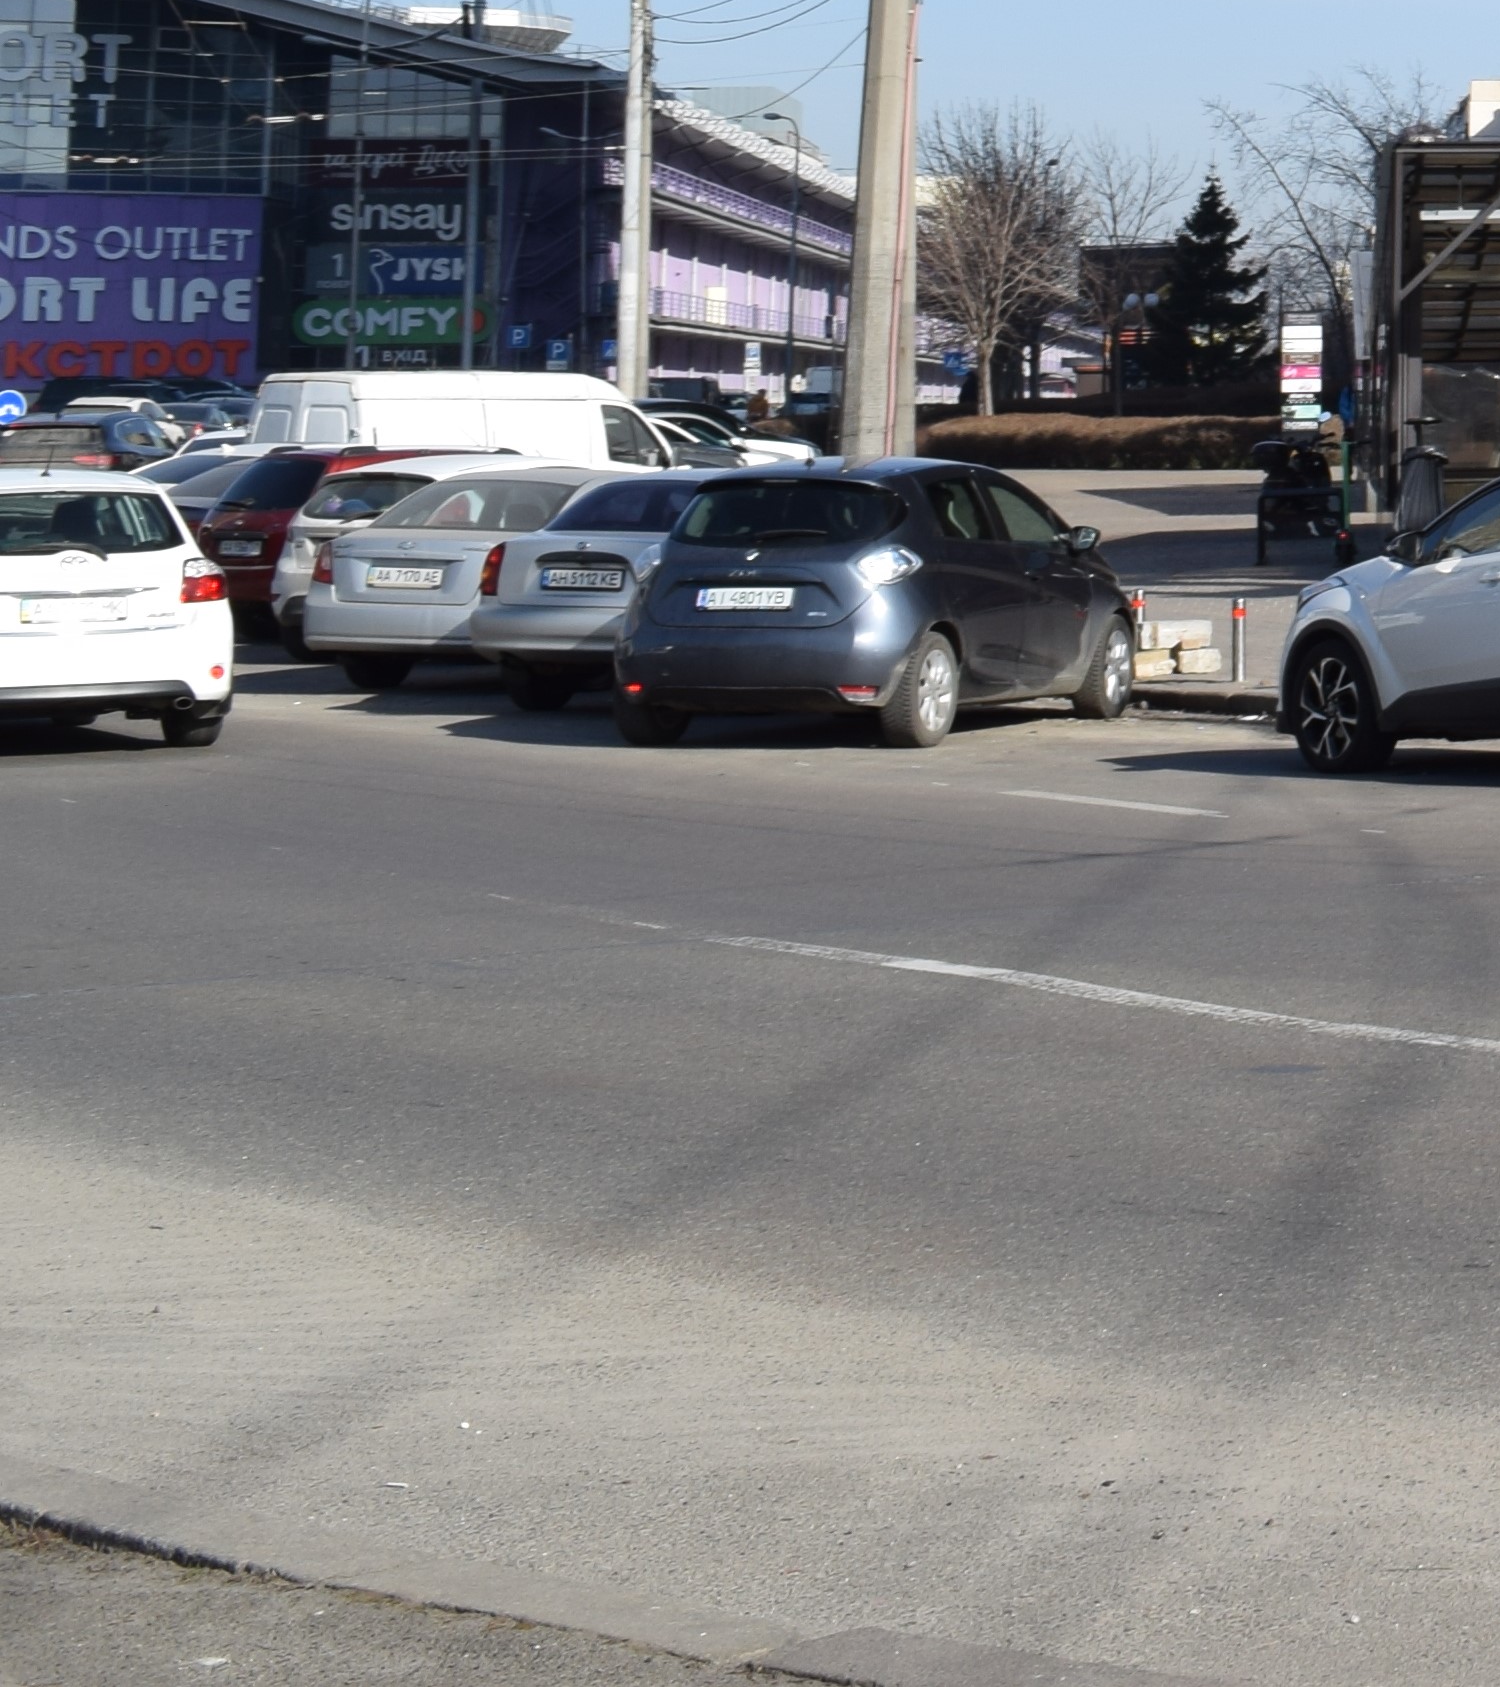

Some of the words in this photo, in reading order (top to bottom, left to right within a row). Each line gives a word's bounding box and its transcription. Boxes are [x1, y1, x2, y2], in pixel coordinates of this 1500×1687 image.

[94, 226, 253, 261] OUTLET
[331, 253, 344, 278] 1
[132, 278, 252, 322] LIFE
[302, 307, 457, 337] COMFY
[355, 345, 370, 367] 1
